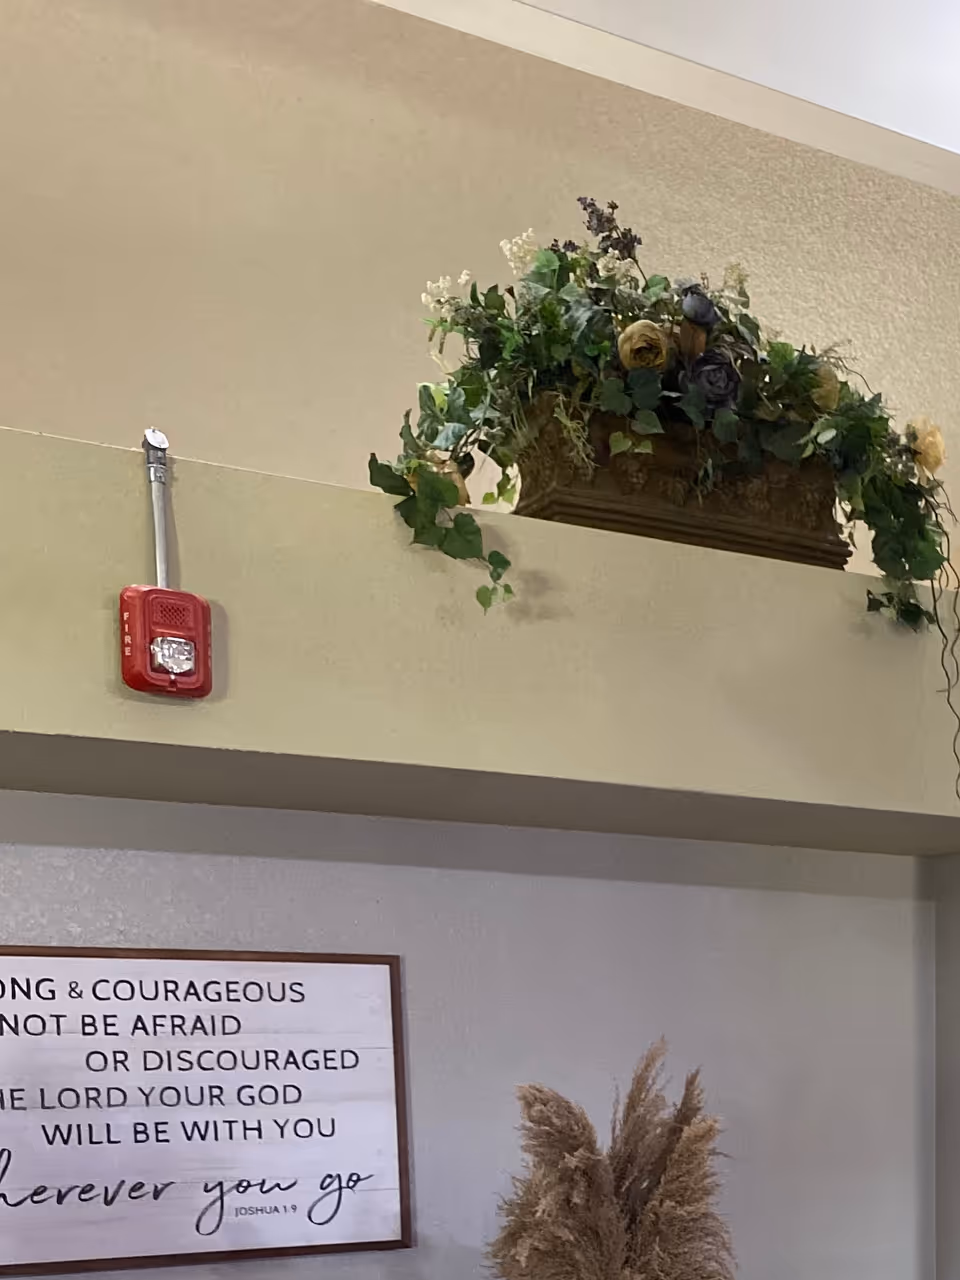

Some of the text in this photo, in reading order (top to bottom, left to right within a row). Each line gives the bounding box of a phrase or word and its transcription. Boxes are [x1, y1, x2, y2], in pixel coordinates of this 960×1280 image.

[123, 612, 132, 656] FIRE
[0, 978, 304, 1002] NG & COURAGEOUS
[0, 1014, 241, 1036] NOT BE AFRAID
[86, 1050, 358, 1072] OR DISCOURAGED
[40, 1087, 127, 1109] LORD
[138, 1086, 225, 1107] YOUR
[237, 1085, 301, 1106] GOD
[42, 1118, 334, 1145] WILL BE WITH YOU
[195, 1178, 298, 1236] you
[307, 1172, 375, 1225] go
[235, 1205, 280, 1218] JOSHUA
